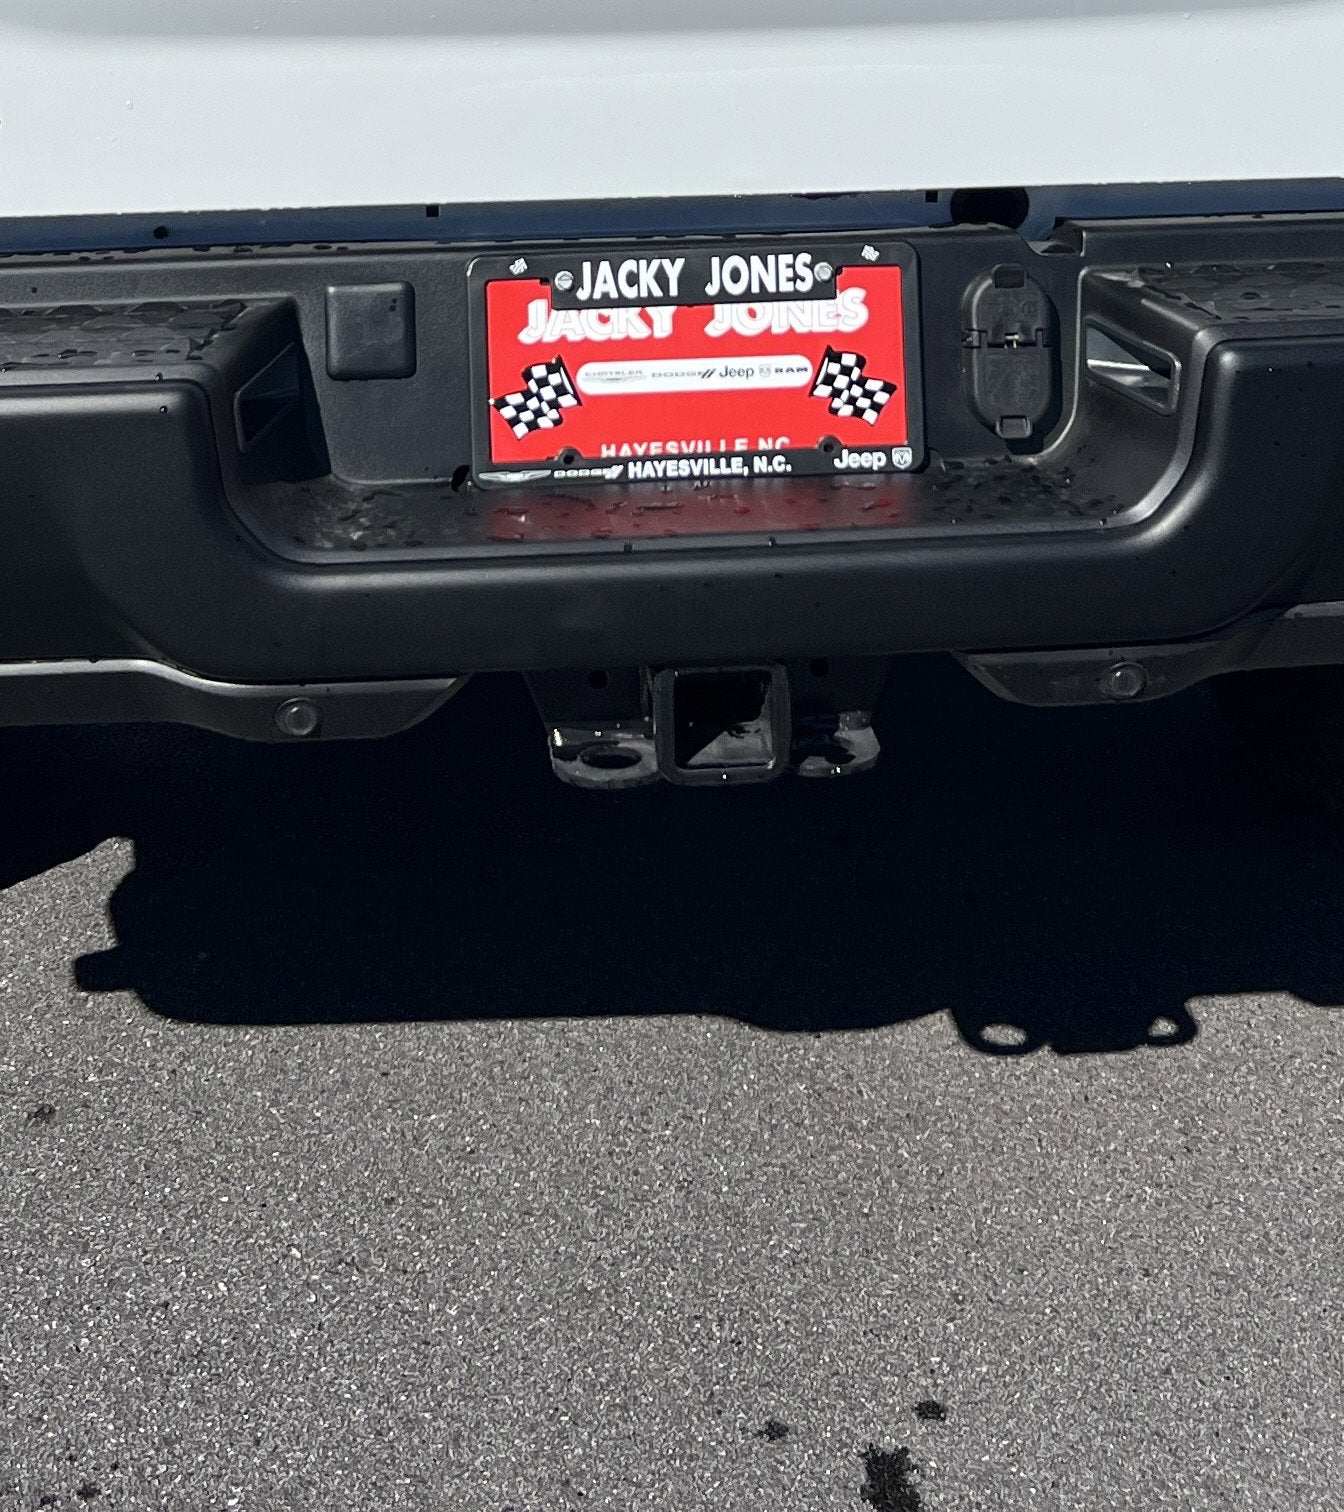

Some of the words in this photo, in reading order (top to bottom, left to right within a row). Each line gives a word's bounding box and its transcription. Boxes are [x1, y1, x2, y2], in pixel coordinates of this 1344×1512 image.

[576, 258, 685, 301] JACKY
[704, 252, 814, 296] JONES
[518, 299, 676, 344] JACKY
[703, 287, 869, 338] JONES
[719, 364, 755, 380] Jeep
[774, 366, 809, 374] RAM
[627, 457, 749, 479] HAYESVILLE,
[753, 455, 792, 473] N.C.
[833, 448, 887, 471] Jeep
